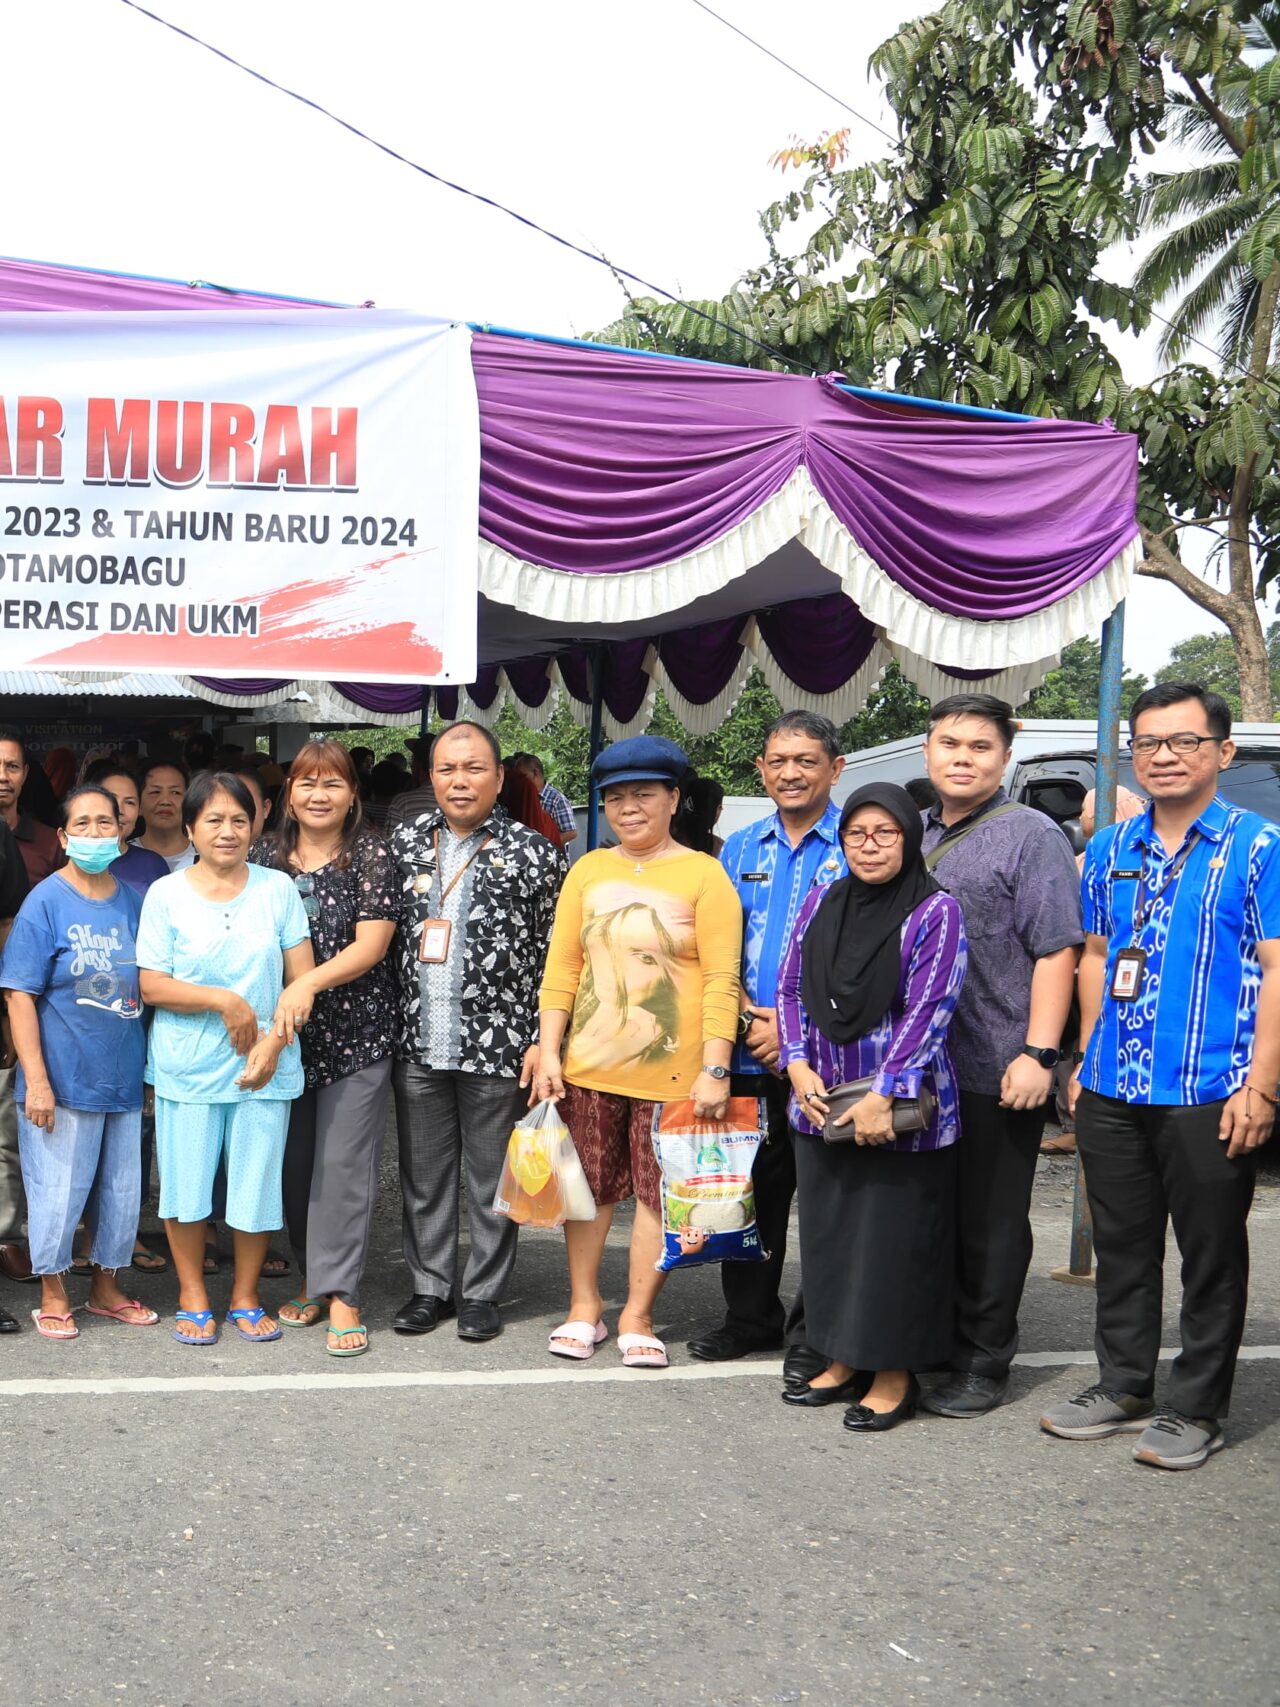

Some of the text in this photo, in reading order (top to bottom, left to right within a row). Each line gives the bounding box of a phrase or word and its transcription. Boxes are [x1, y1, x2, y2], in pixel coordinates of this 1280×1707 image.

[83, 396, 360, 493] MURAH
[5, 506, 80, 538] 2023
[91, 508, 115, 538] &
[124, 510, 233, 541] TAHUN
[245, 513, 330, 544] BARU
[341, 515, 417, 547] 2024
[109, 603, 176, 632] DAN
[187, 605, 258, 634] UKM
[25, 724, 102, 735] VISITATION
[721, 1135, 759, 1145] BUMN
